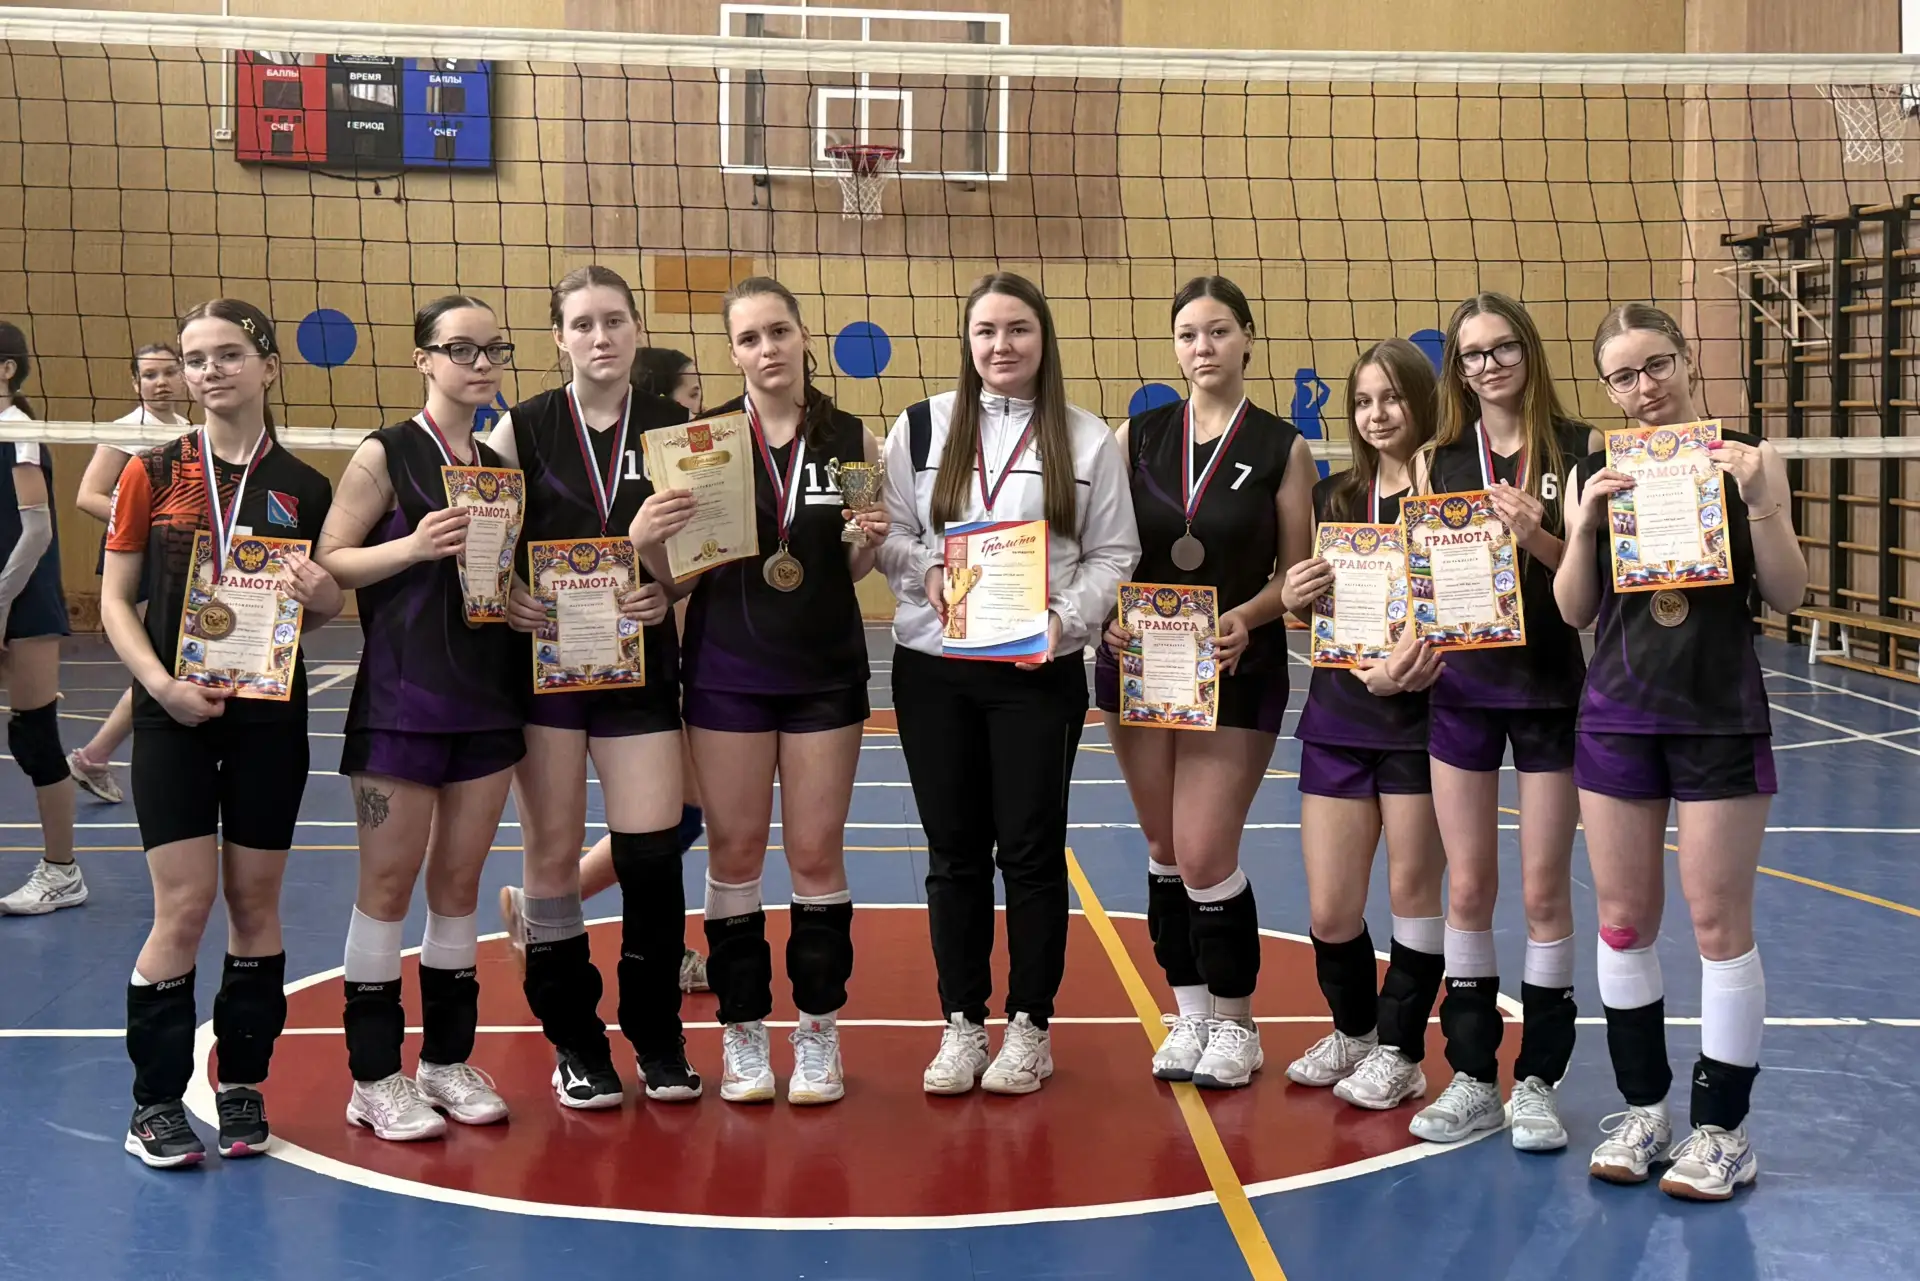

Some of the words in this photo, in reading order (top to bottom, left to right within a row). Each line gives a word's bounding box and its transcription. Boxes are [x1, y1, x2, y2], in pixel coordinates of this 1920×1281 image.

[266, 69, 299, 77] БАЛЛЫ
[350, 72, 382, 81] ВРЕМЯ
[624, 449, 652, 481] 1
[1629, 463, 1700, 480] ГРАМОТА
[1230, 462, 1253, 490] 7
[1541, 472, 1558, 500] 6
[465, 505, 511, 519] ГРАМОТА
[981, 535, 1036, 558] Грамота
[1424, 531, 1493, 547] ГРАМОТА
[1331, 558, 1393, 571] ГРАМОТА
[211, 574, 284, 591] РАМОТА
[551, 577, 619, 591] ГРАМОТА
[1137, 619, 1200, 632] ГРАМОТА
